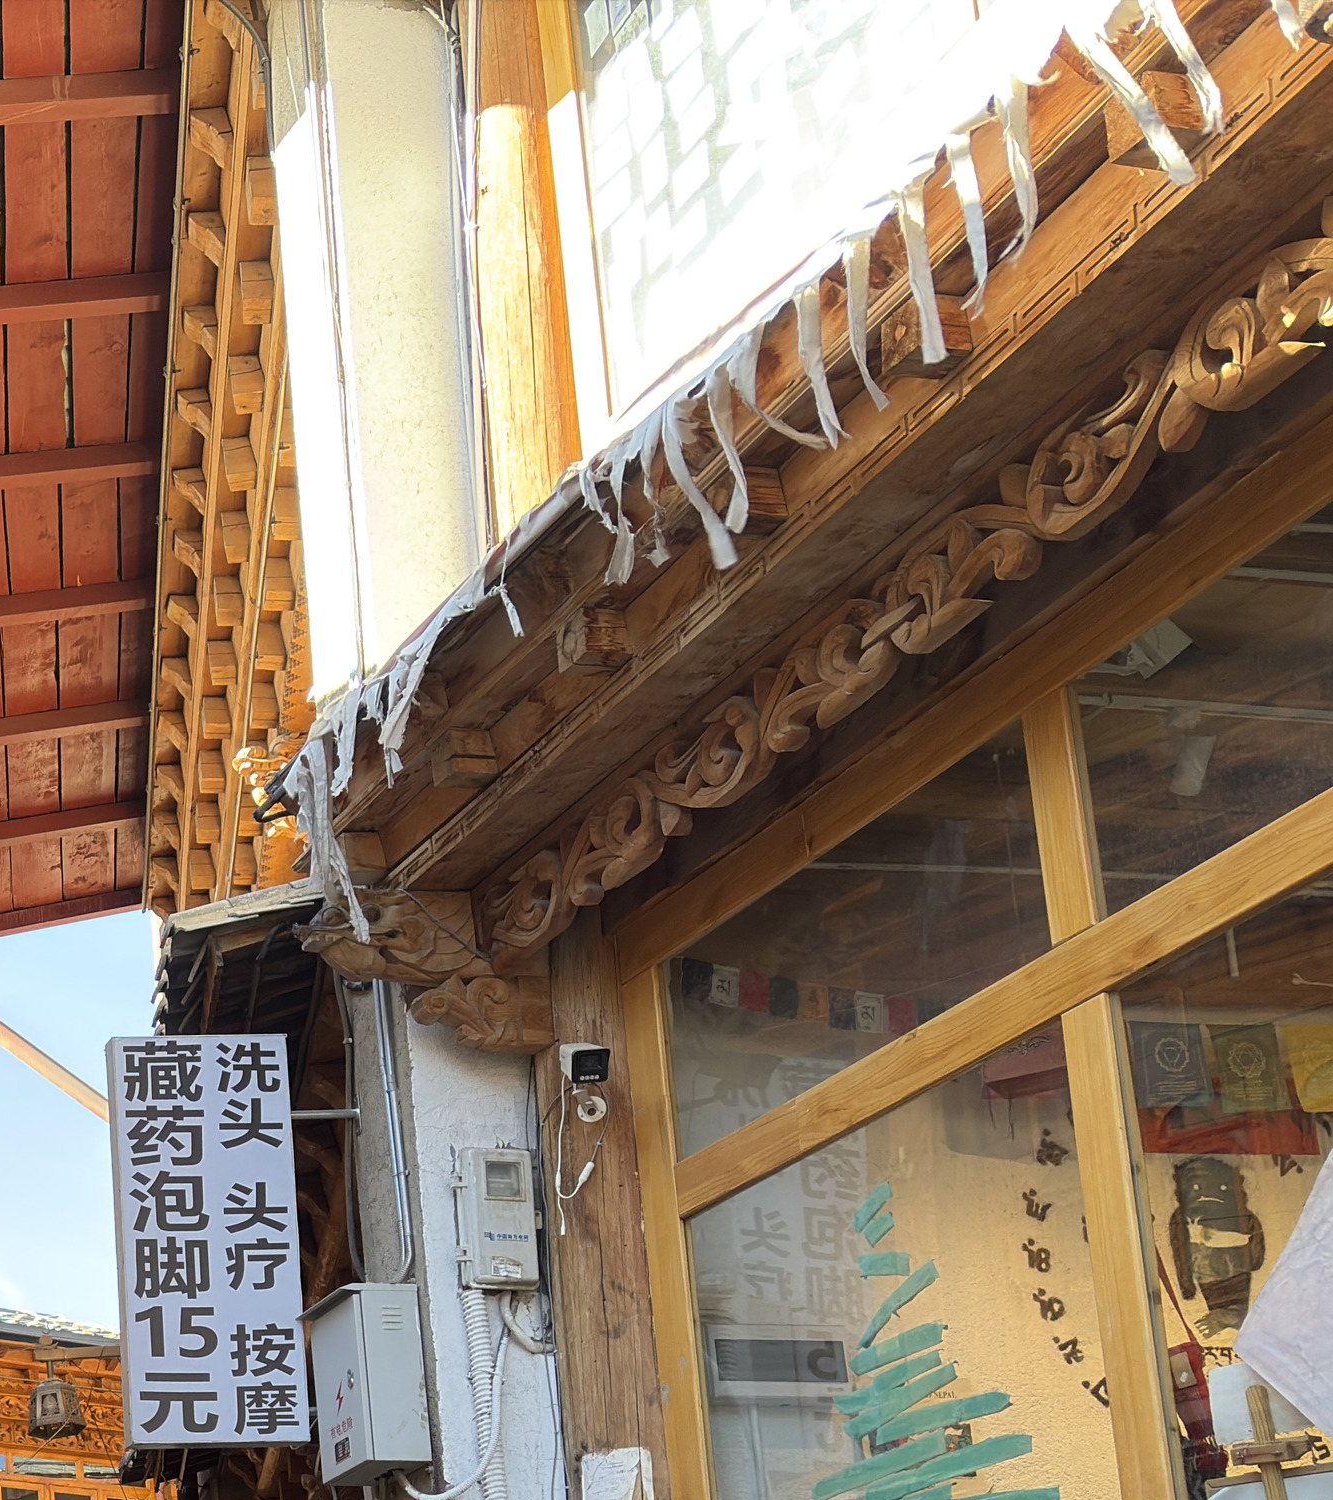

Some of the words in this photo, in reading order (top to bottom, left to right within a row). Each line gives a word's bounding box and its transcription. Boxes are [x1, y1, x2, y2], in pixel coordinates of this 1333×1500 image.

[216, 1042, 284, 1149] 洗头
[122, 1040, 220, 1433] 藏药泡脚15元
[222, 1181, 290, 1291] 头疗
[230, 1323, 299, 1435] 按摩
